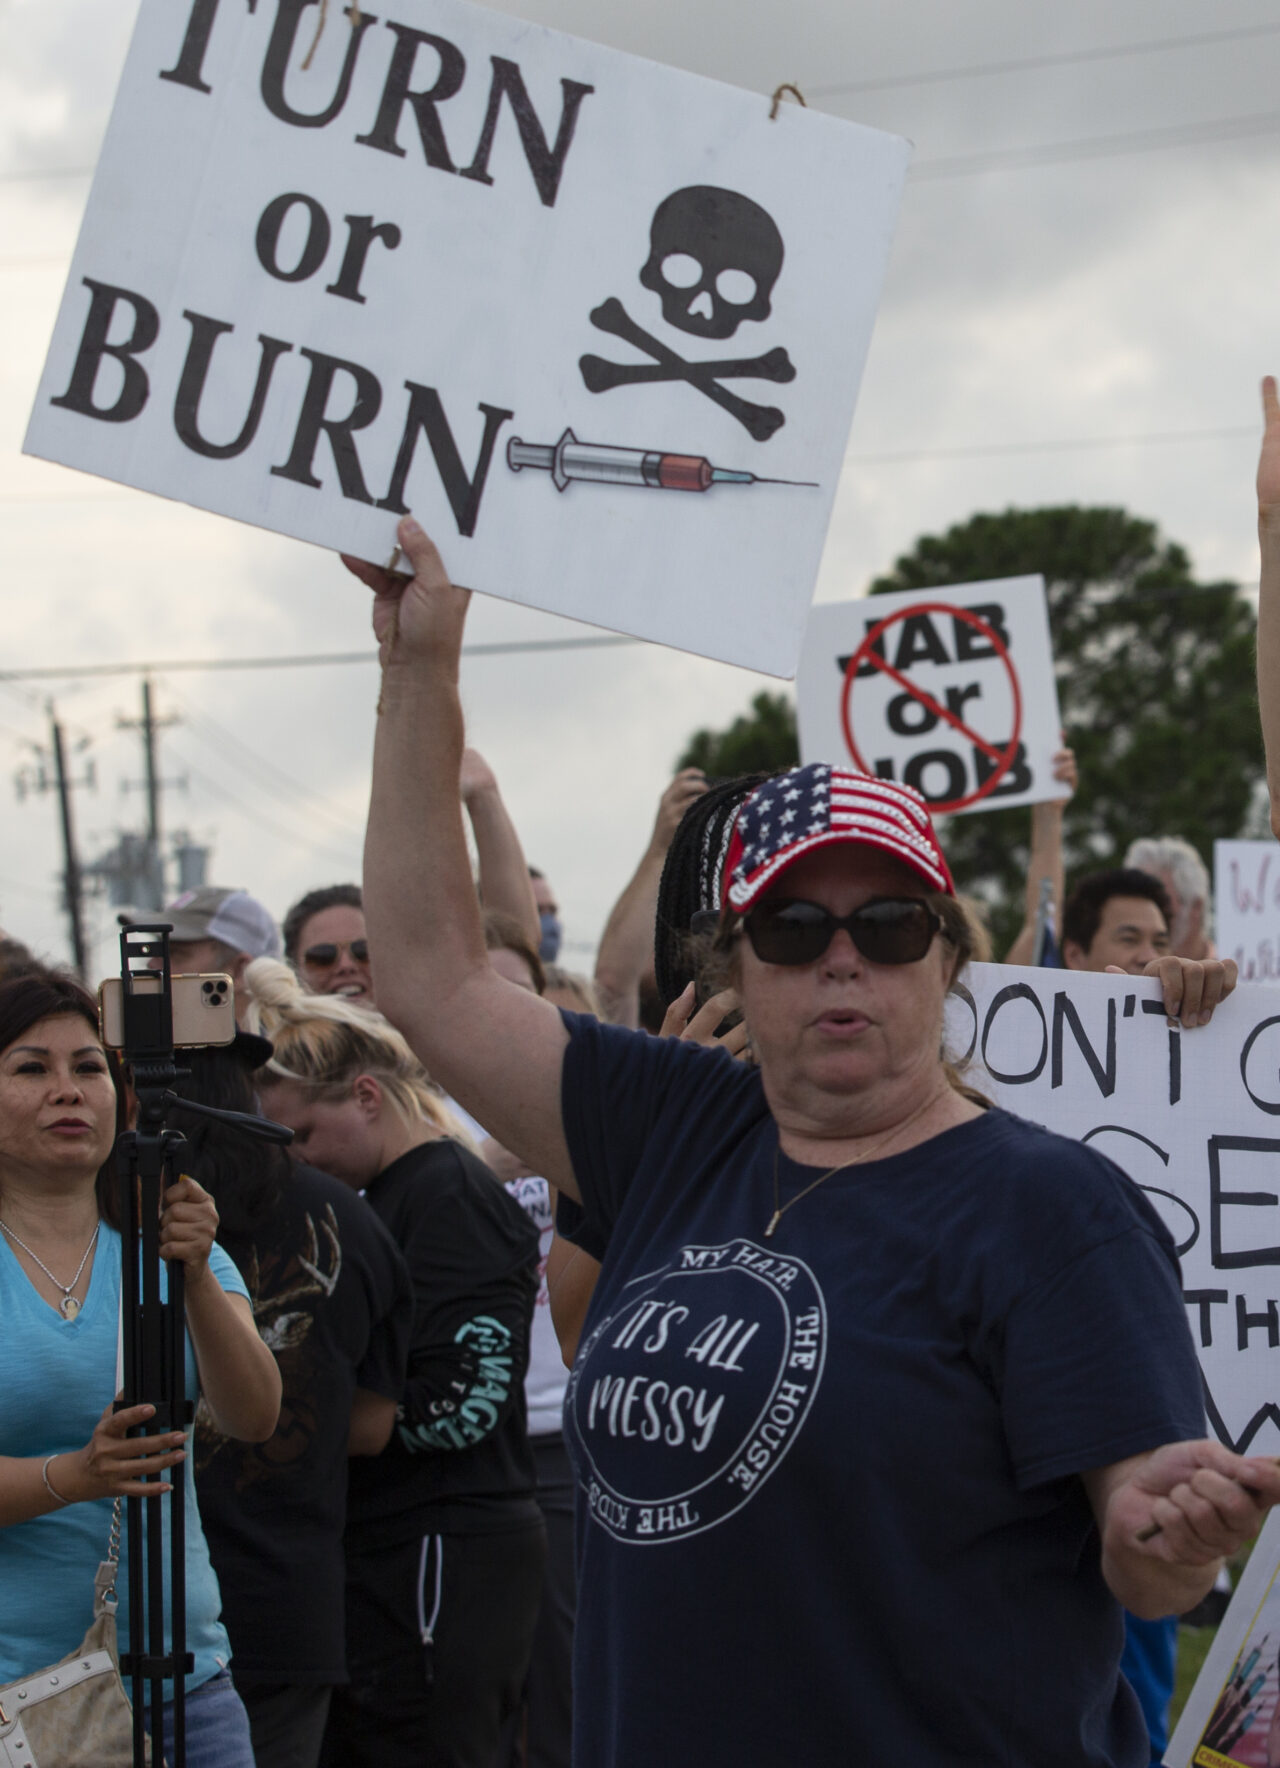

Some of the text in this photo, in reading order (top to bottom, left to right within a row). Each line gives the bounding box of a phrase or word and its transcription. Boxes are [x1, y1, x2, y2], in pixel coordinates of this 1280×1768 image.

[158, 0, 595, 208] TURN
[254, 192, 401, 304] or
[49, 276, 515, 539] BURN
[836, 604, 1010, 678] JAB
[886, 682, 981, 738] or
[681, 1249, 730, 1269] MY
[612, 1300, 760, 1373] IT'S ALL
[789, 1305, 820, 1371] THE
[588, 1374, 725, 1452] MESSY
[636, 1501, 700, 1534] THE
